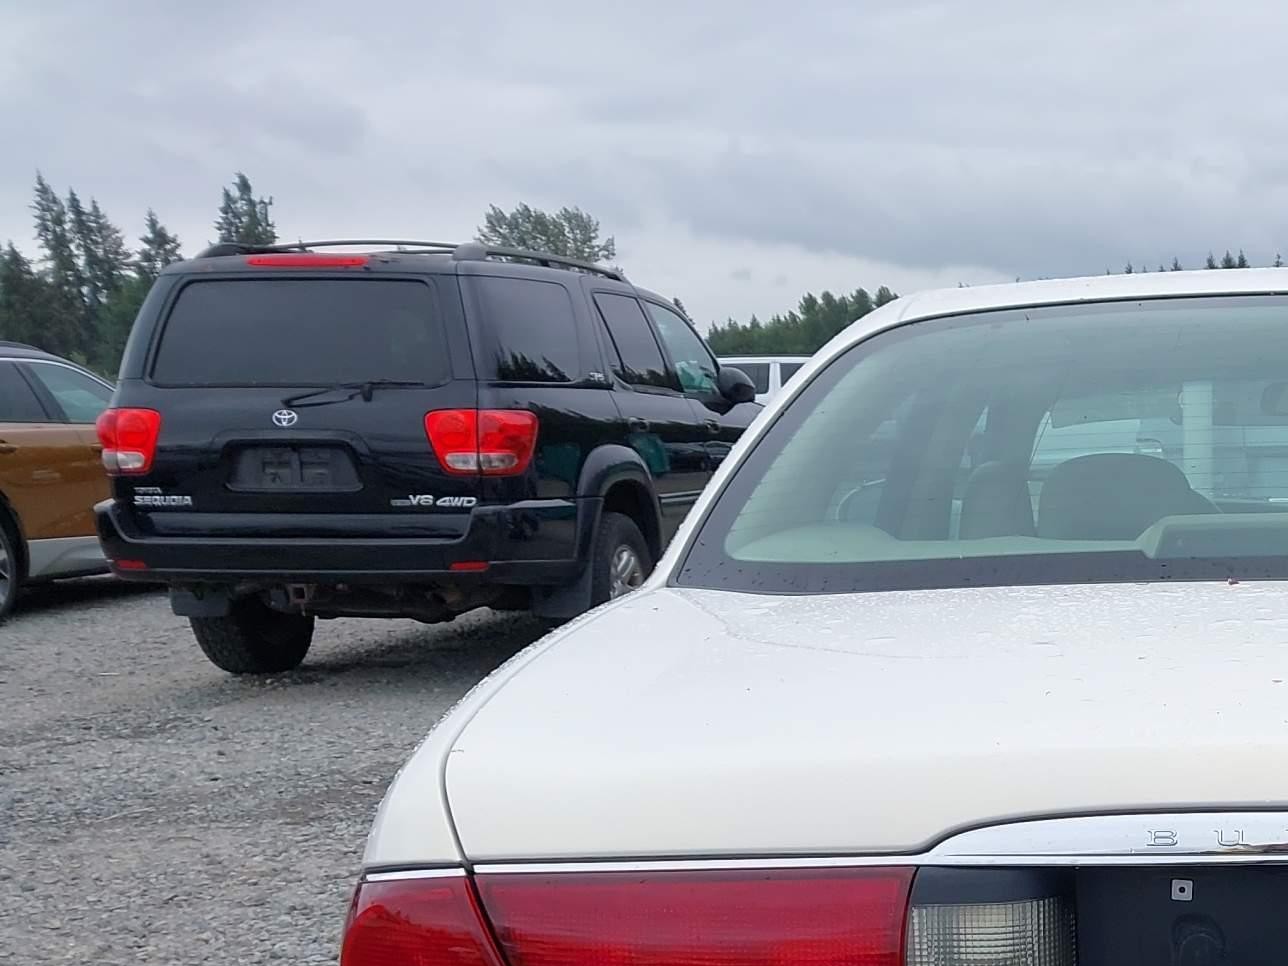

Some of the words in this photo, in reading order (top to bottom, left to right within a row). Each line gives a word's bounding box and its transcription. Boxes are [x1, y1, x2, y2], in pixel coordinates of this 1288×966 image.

[133, 495, 192, 506] SEQUOIA
[408, 494, 434, 506] V8
[435, 496, 477, 507] 4WD
